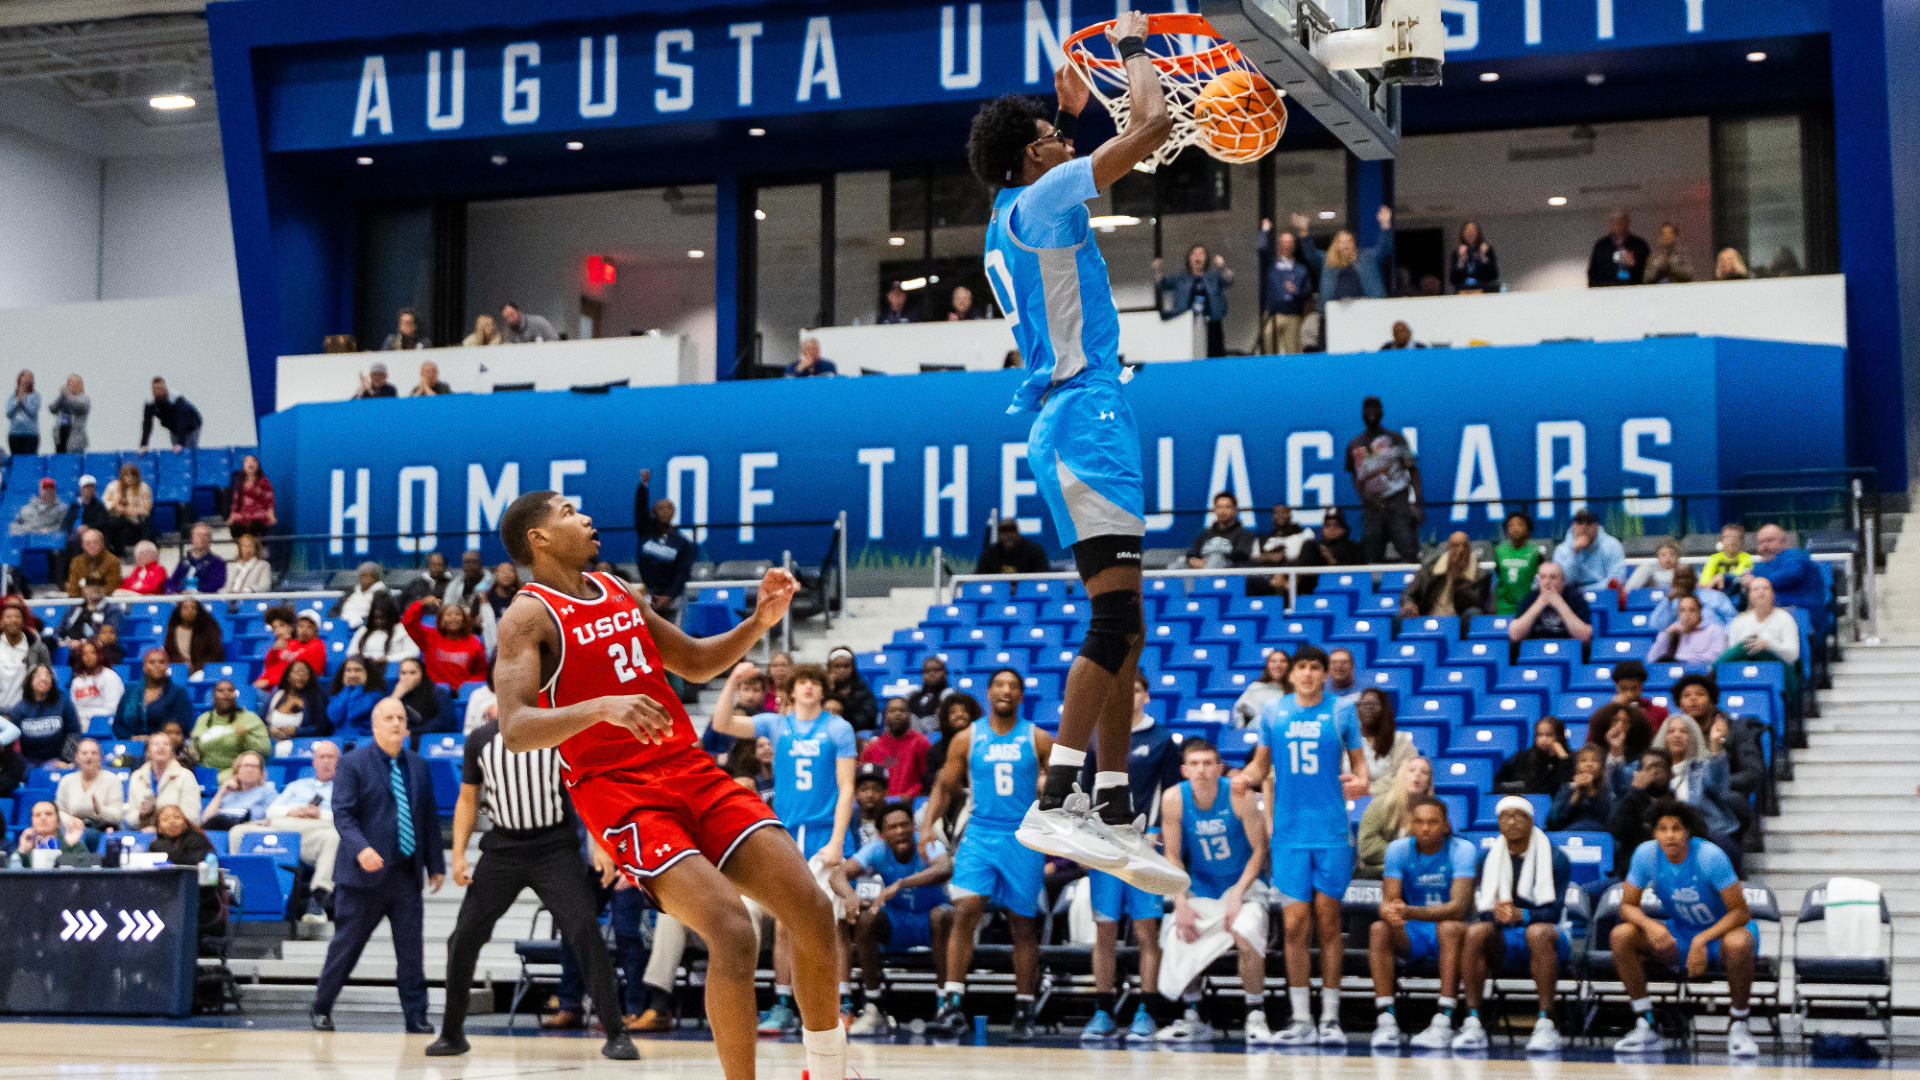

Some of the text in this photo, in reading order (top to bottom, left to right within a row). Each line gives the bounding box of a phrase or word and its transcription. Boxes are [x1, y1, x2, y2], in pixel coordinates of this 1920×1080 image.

[352, 15, 842, 137] AUGUSTA
[329, 417, 1674, 555] HOME OF THE JAGARS
[572, 607, 645, 646] USCA
[607, 636, 653, 684] 24
[1284, 720, 1322, 739] JAGS
[788, 739, 821, 757] JAGS
[983, 743, 1022, 762] JAGS
[1287, 740, 1319, 775] 15
[795, 758, 813, 791] 5
[994, 762, 1014, 797] 6
[1195, 818, 1227, 836] JAGS
[1198, 835, 1232, 862] 13
